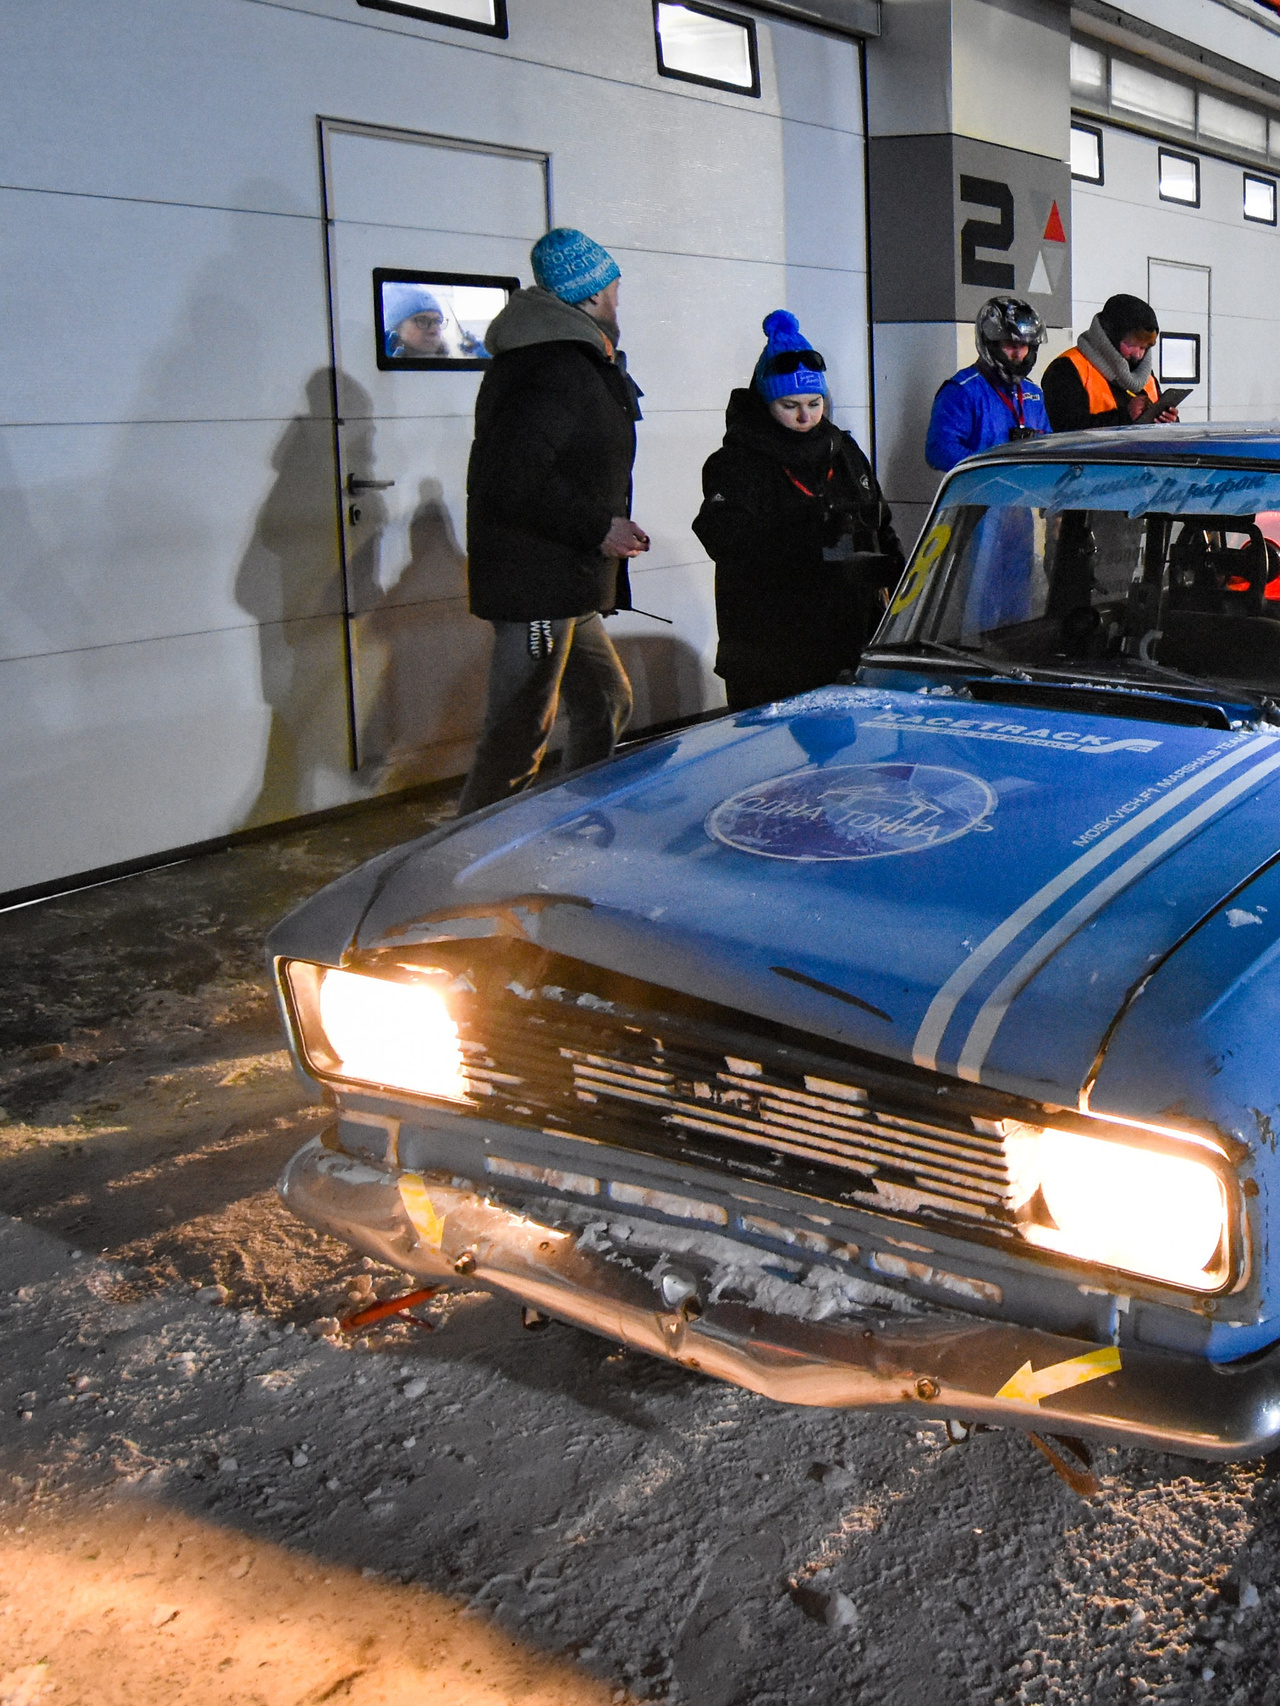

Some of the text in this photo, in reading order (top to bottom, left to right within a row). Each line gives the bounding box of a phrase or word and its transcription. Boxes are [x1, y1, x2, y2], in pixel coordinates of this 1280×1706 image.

[961, 173, 1015, 290] 2
[891, 523, 952, 615] 8
[1157, 749, 1221, 788] MARSHALS
